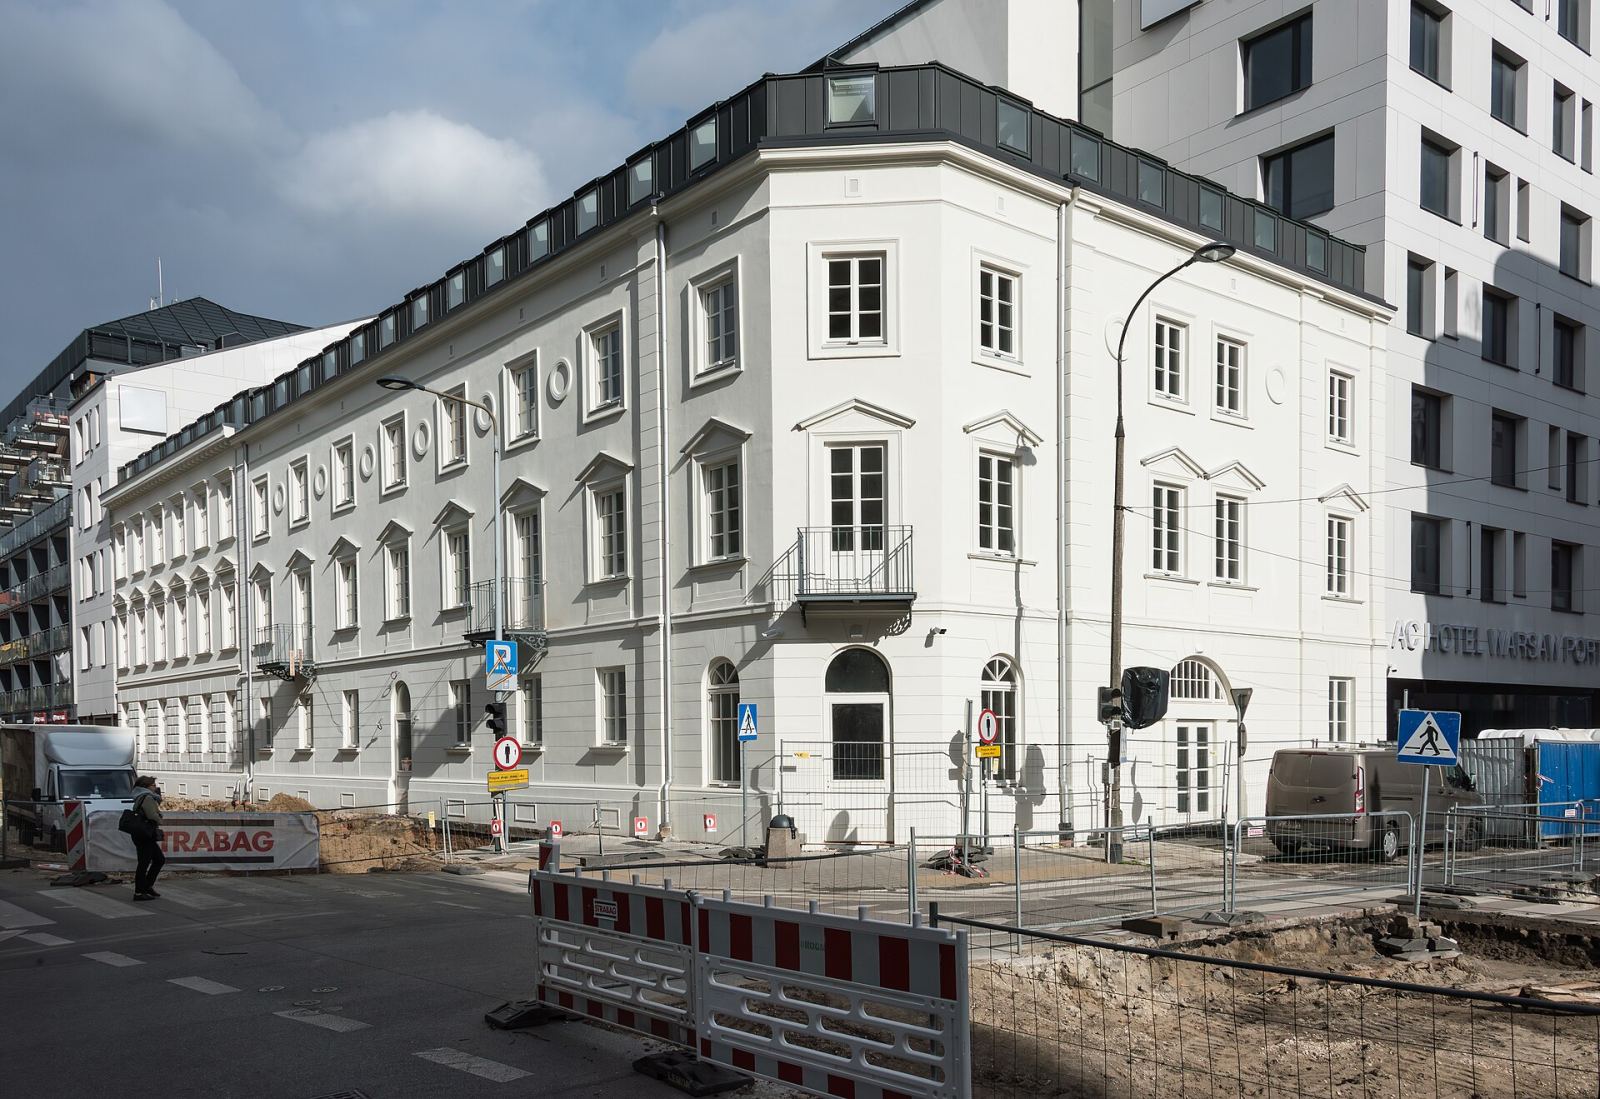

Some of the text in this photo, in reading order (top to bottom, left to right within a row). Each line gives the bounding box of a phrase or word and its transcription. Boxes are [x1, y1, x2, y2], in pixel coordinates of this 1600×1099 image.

[1391, 620, 1420, 651] AC
[1423, 622, 1484, 656] HOTEL
[162, 830, 274, 853] TRABAG
